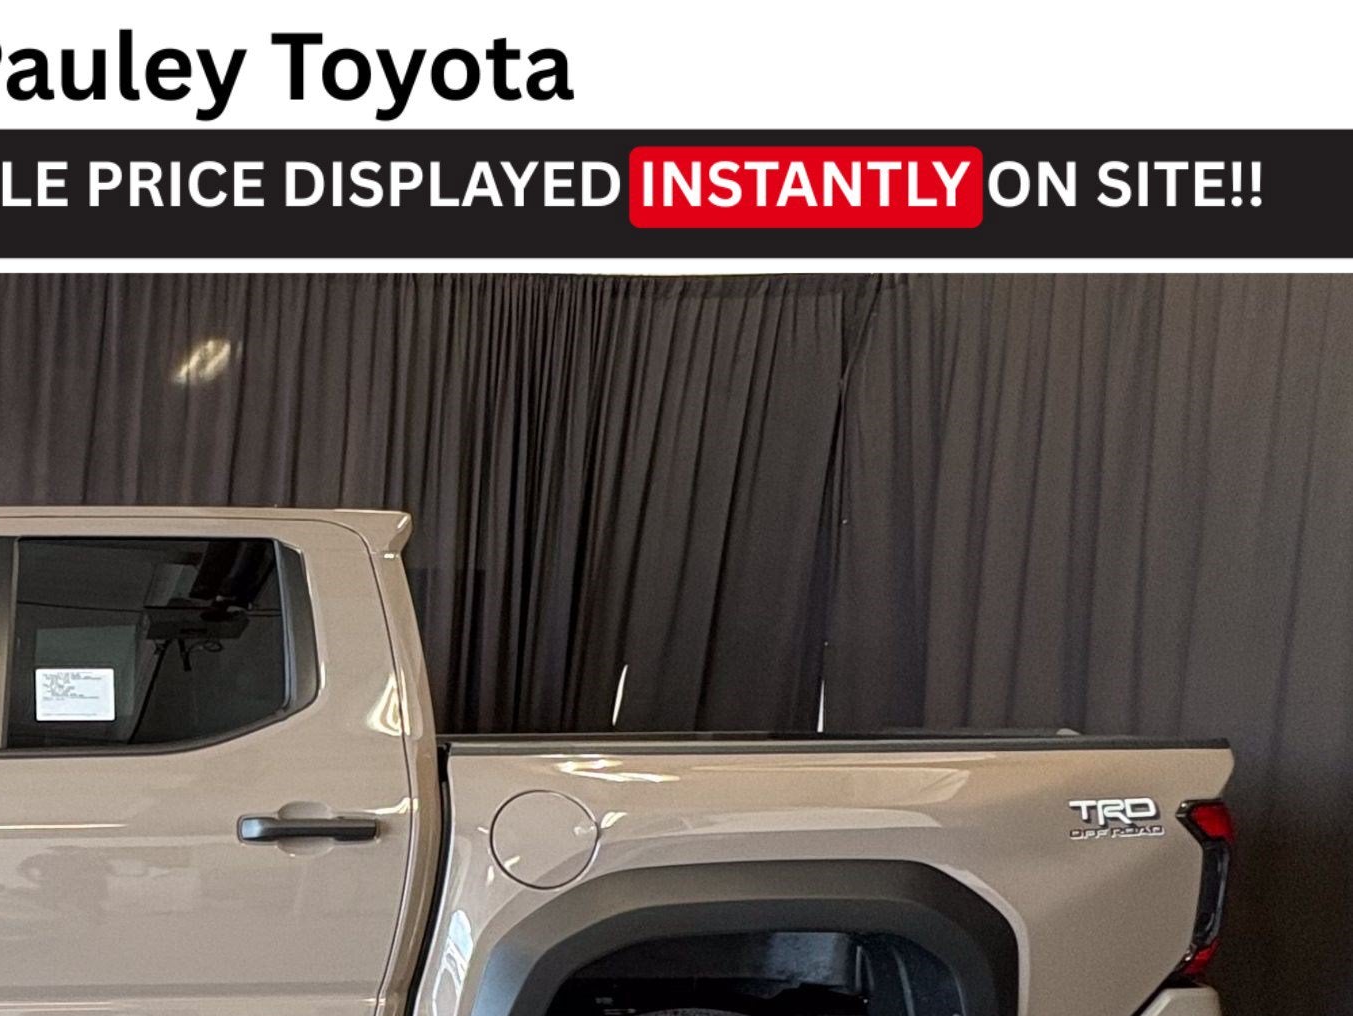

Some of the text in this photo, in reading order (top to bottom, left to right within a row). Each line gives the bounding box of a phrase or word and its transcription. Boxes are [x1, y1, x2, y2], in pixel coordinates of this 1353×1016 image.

[1068, 797, 1158, 827] TRD
[1069, 824, 1166, 840] OFF ROAD
